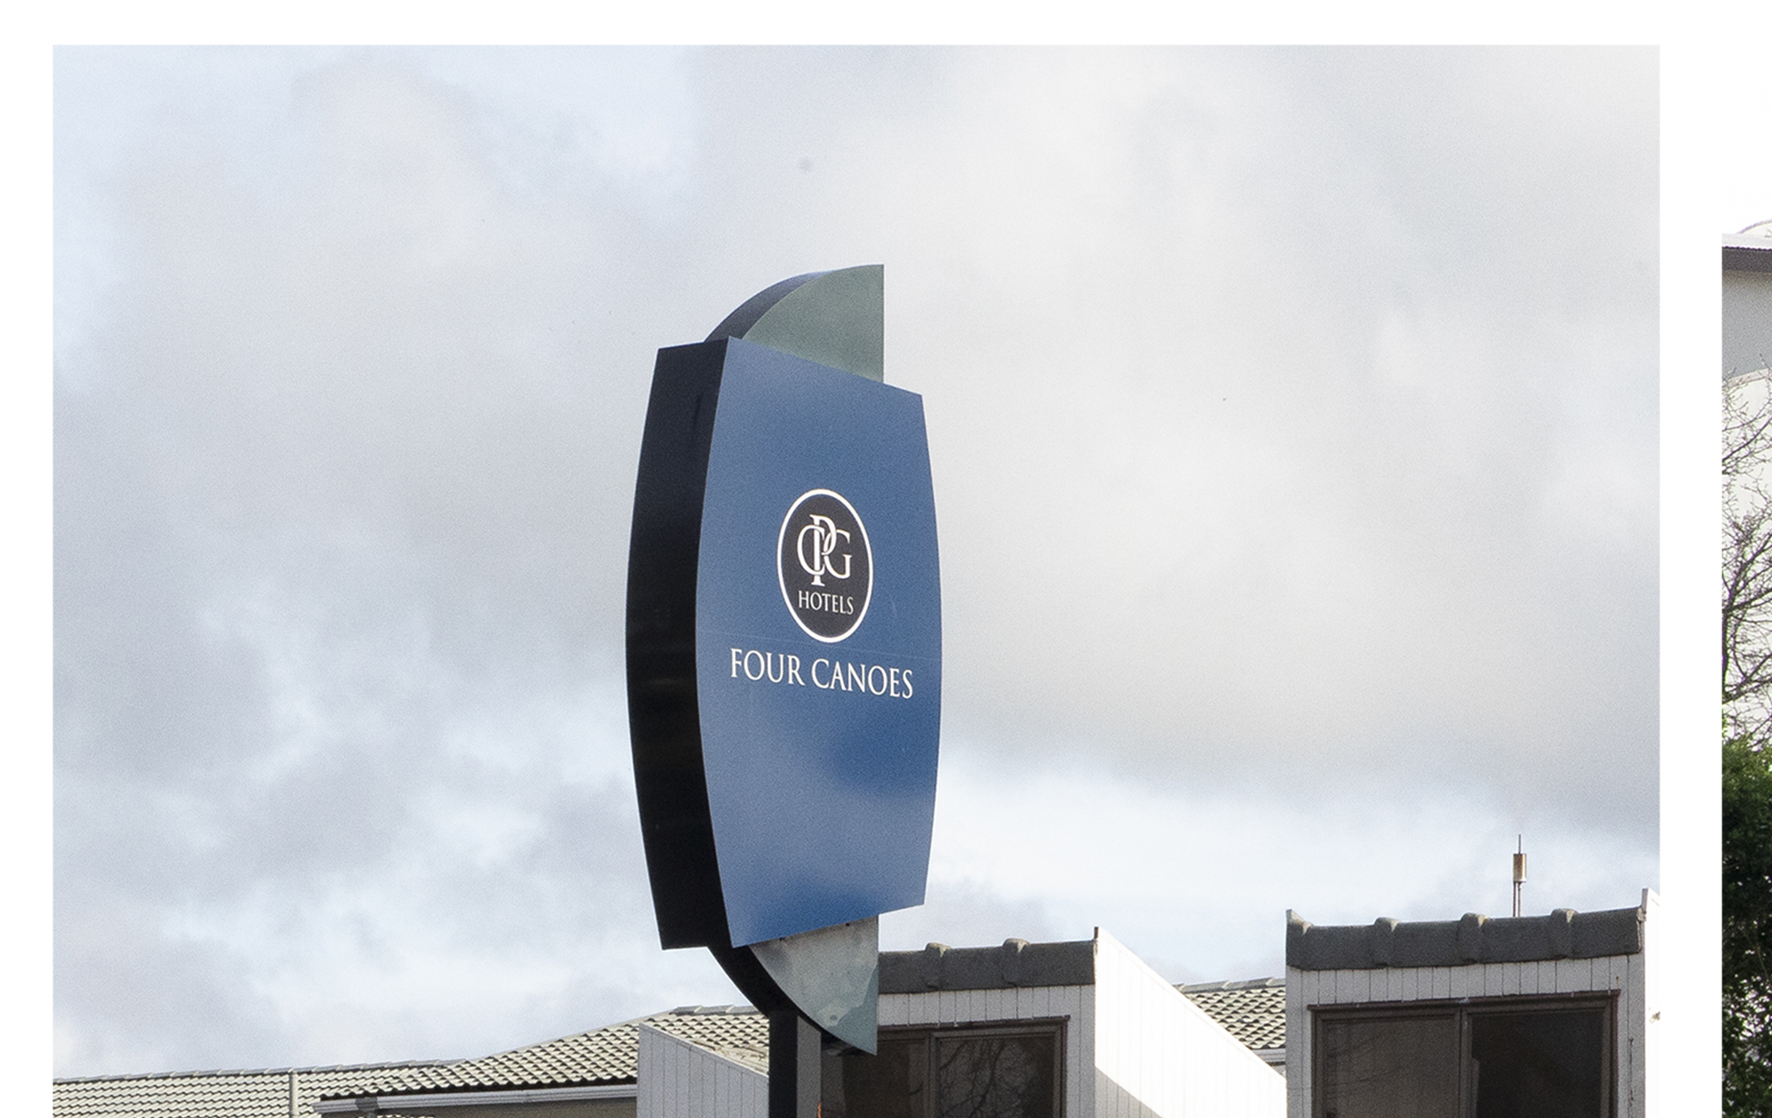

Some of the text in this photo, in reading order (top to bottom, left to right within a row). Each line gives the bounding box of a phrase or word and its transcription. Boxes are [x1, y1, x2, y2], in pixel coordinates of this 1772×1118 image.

[798, 590, 854, 615] HOTELS
[730, 647, 914, 699] FOUR CANOES
